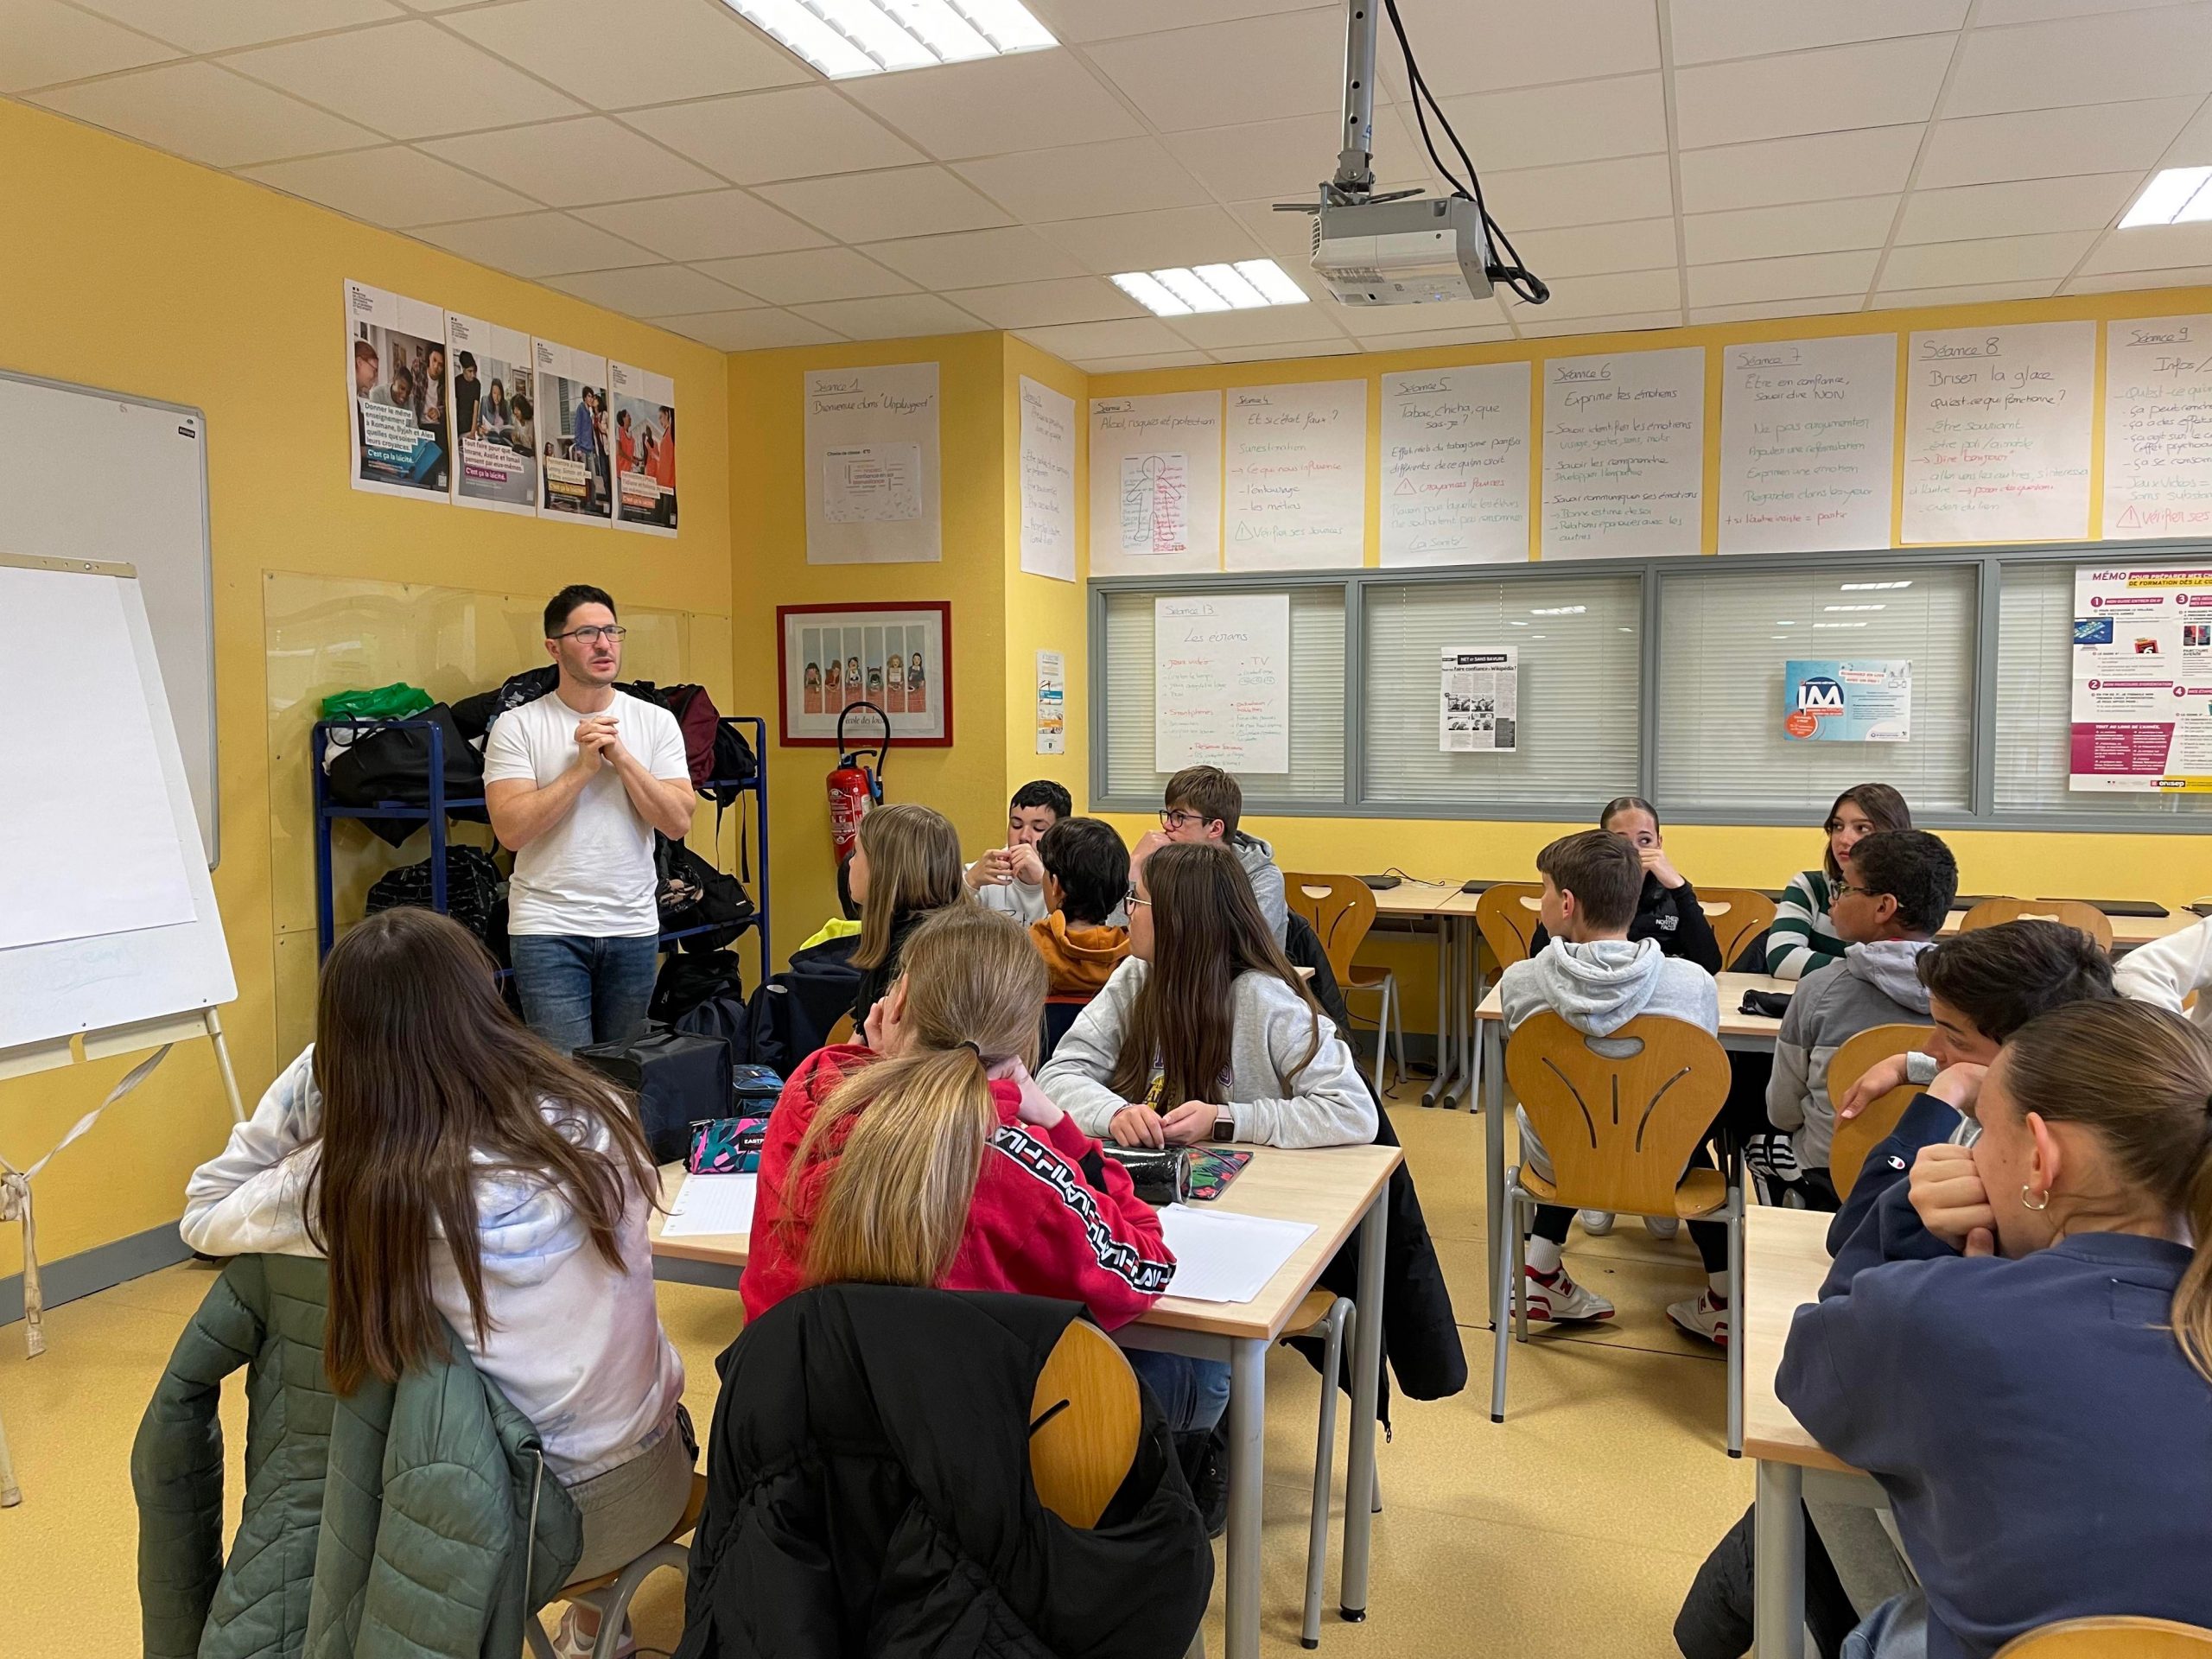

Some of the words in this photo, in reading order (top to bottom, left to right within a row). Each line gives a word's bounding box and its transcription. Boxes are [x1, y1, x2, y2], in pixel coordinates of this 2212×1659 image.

[2130, 329, 2175, 345] Séance
[2179, 327, 2189, 341] 9
[1790, 347, 1802, 361] 7
[1923, 340, 1982, 358] Séance
[1986, 337, 1999, 355] 8
[1554, 367, 1597, 382] Séance
[1600, 363, 1611, 378] 6
[1929, 370, 1978, 387] Briser
[1992, 365, 2005, 381] la
[2011, 365, 2055, 390] glace
[1440, 377, 1451, 390] 5
[1814, 390, 1845, 400] NON
[365, 402, 387, 411] Donner
[395, 409, 411, 417] même
[1475, 404, 1500, 420] que
[365, 412, 404, 424] enseignement
[366, 429, 387, 438] quelles
[1776, 423, 1801, 443] pas
[367, 449, 382, 458] C'est
[2092, 571, 2126, 581] MÉMO
[1203, 605, 1214, 615] 13
[1184, 628, 1204, 643] Les
[1209, 632, 1249, 643] écrans
[1251, 656, 1270, 666] TV
[845, 715, 860, 724] école
[861, 715, 870, 724] des
